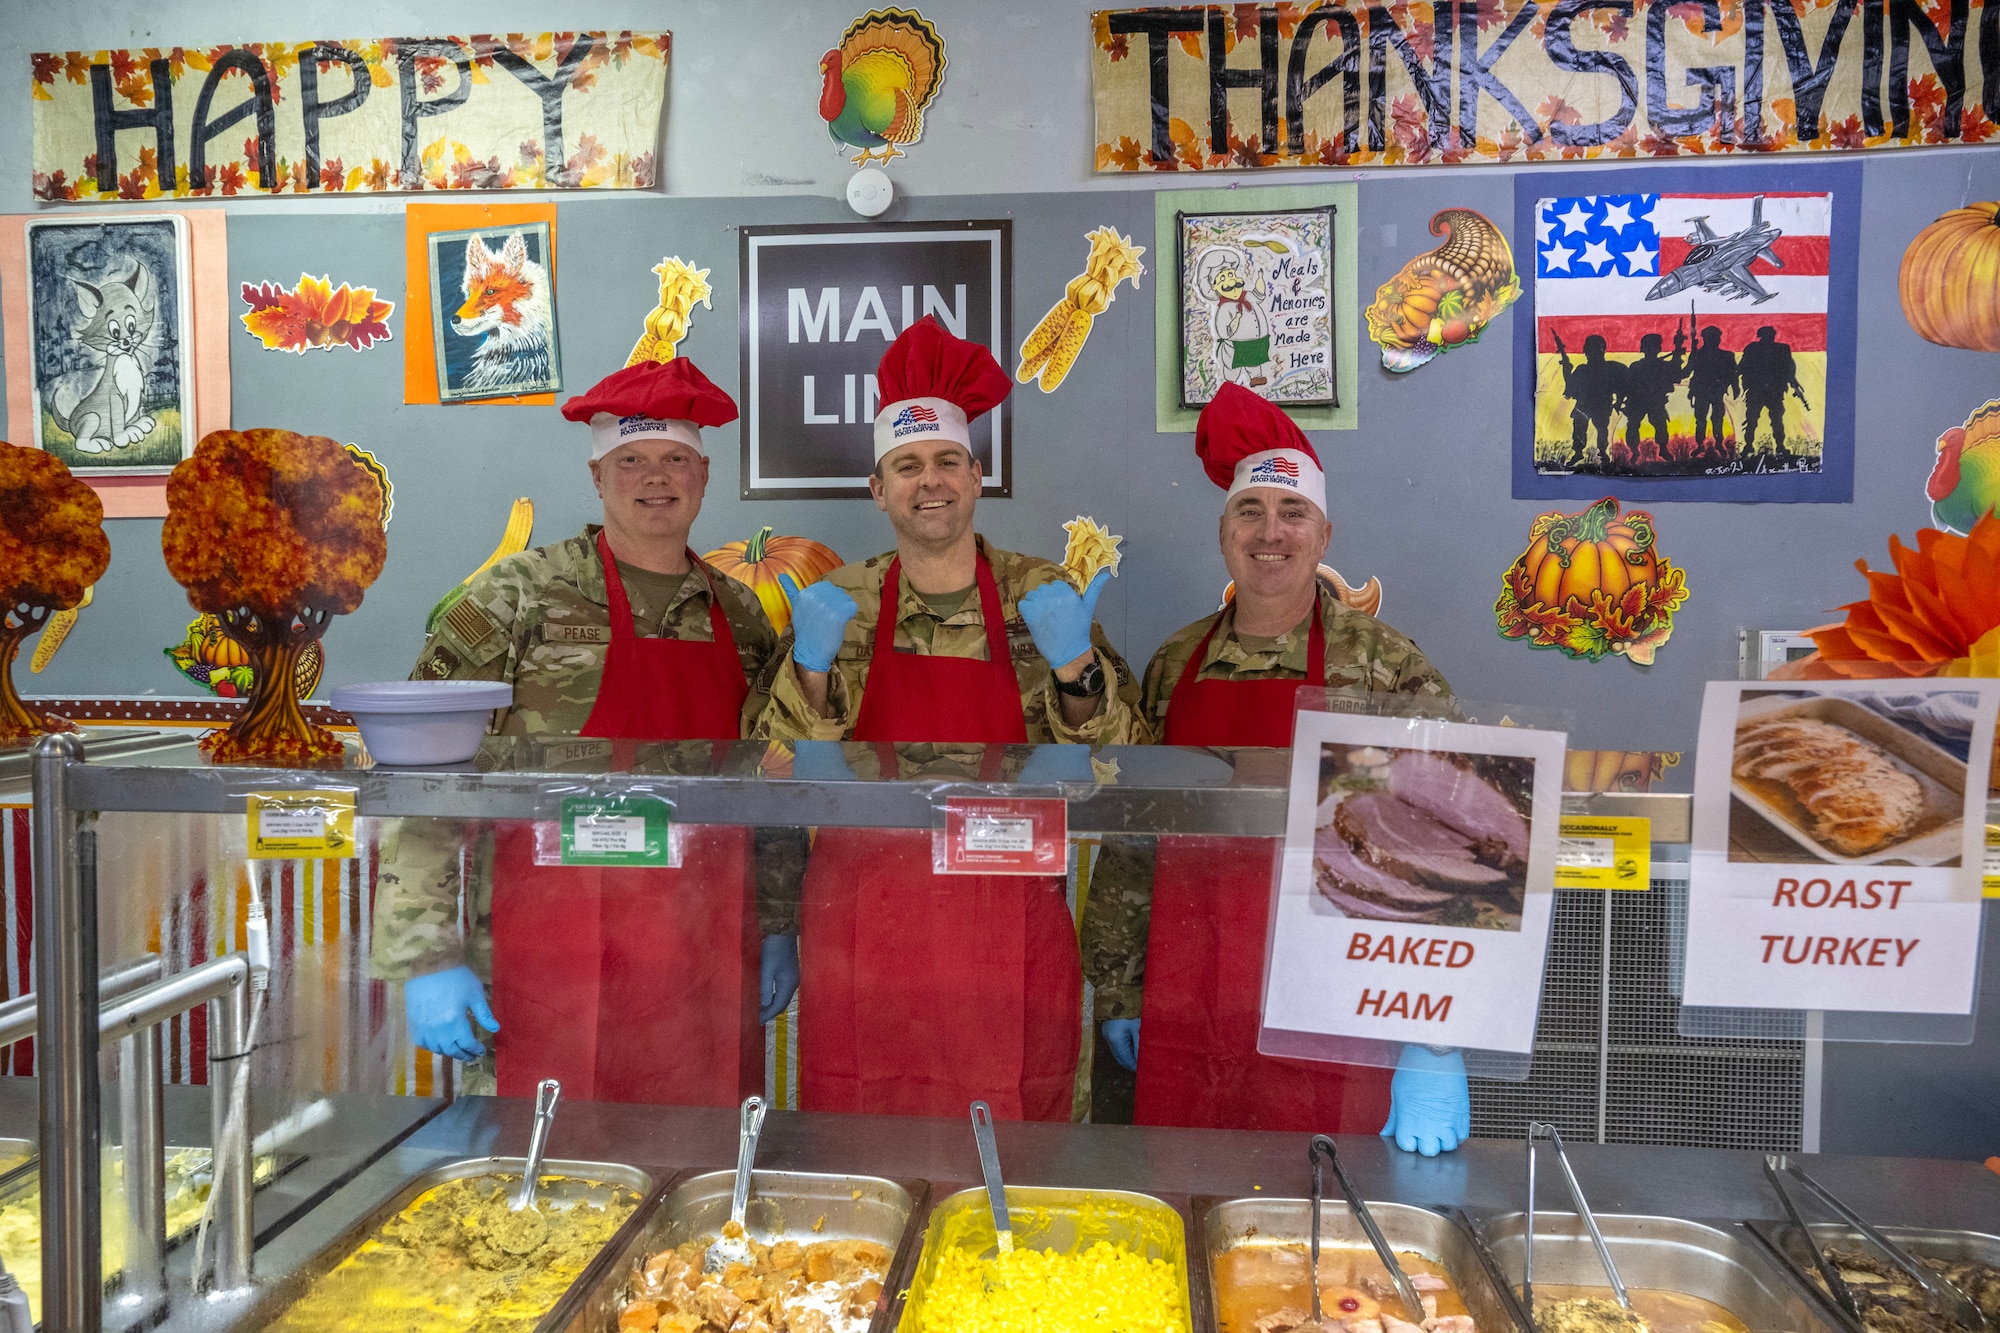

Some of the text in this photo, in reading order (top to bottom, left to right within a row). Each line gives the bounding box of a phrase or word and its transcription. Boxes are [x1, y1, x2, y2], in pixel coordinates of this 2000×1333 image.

[1108, 0, 2000, 162] THANKSGIVIN
[91, 34, 594, 191] HAPPY
[1273, 257, 1318, 279] Meals
[1291, 278, 1301, 295] &
[788, 284, 967, 343] MAIN
[1285, 315, 1309, 326] are
[1274, 329, 1311, 346] Made
[1290, 352, 1324, 368] Here
[564, 627, 601, 641] PEASE
[1560, 824, 1618, 832] OCCASIONALLY
[1772, 878, 1912, 910] ROAST
[1346, 932, 1475, 968] BAKED
[1760, 935, 1920, 968] TURKEY
[1356, 988, 1453, 1022] HAM
